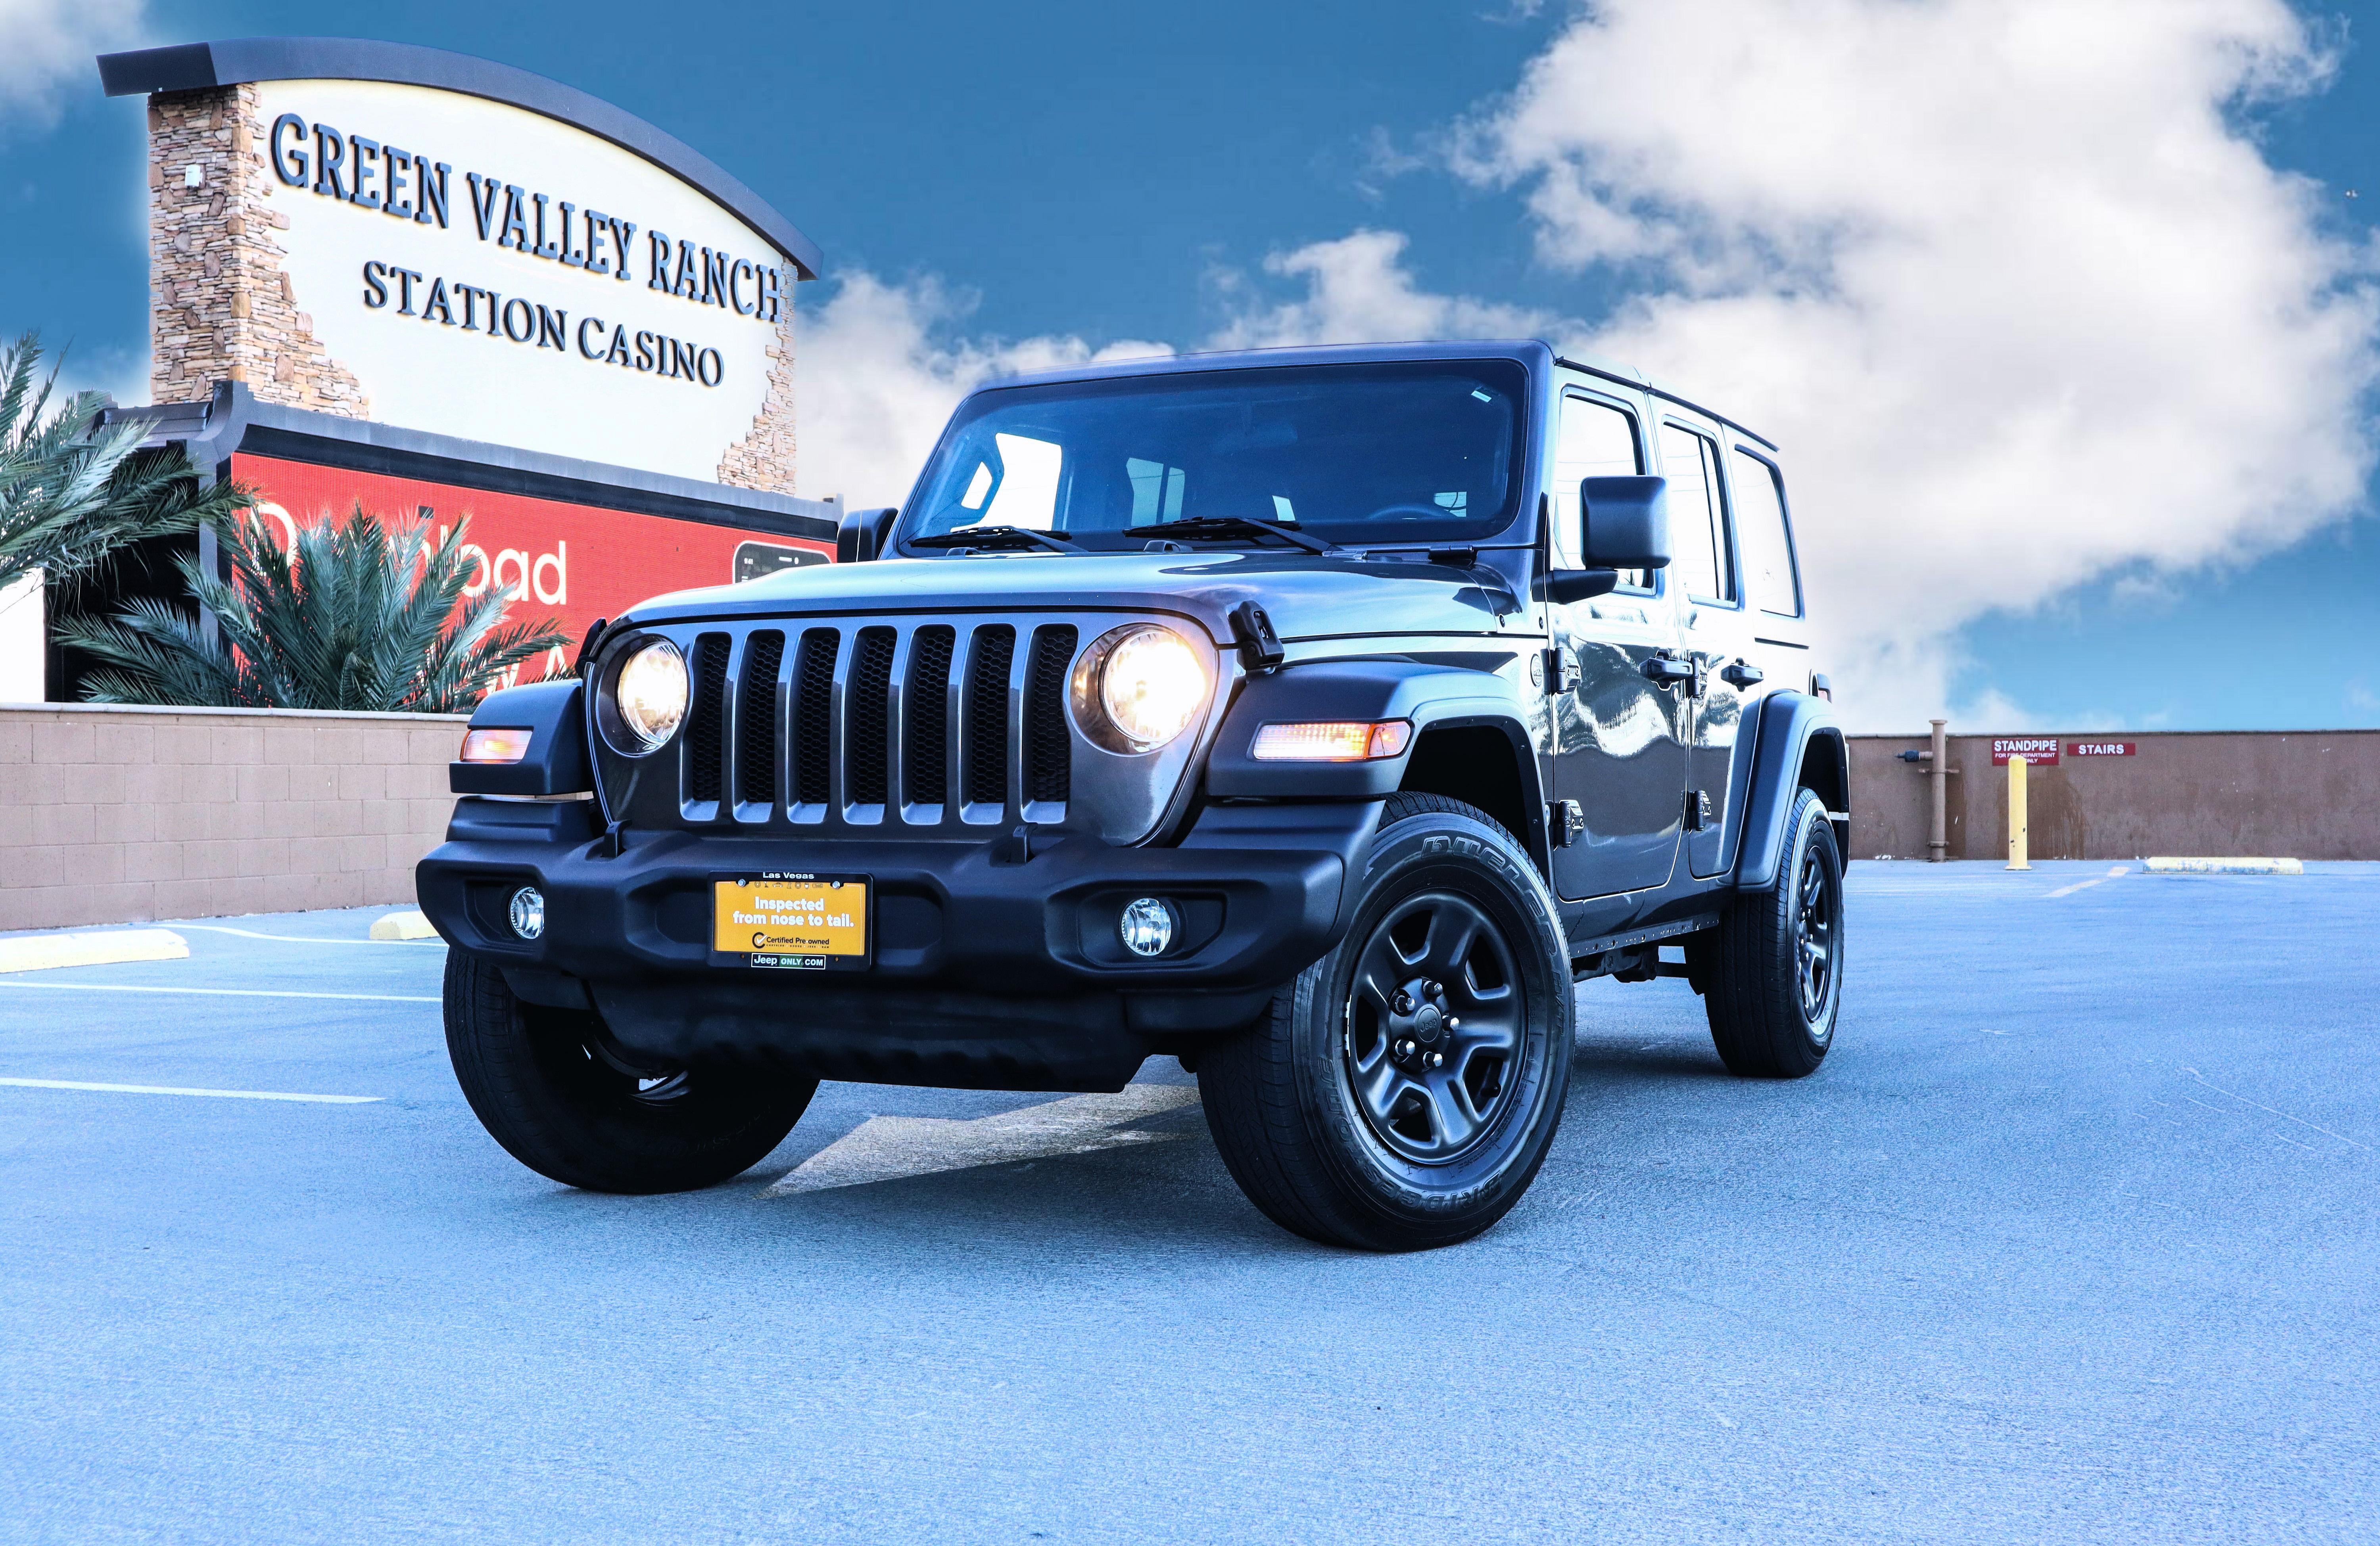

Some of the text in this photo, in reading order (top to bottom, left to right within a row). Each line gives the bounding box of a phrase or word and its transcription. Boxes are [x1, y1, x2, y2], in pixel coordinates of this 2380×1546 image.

[271, 113, 782, 322] GREEN VALLEY RANCH
[363, 261, 724, 387] STATION CASINO
[249, 501, 566, 605] Doad
[1994, 740, 2057, 752] STANDPIPE
[2079, 744, 2124, 755] STAIRS
[755, 896, 824, 912] Inspected
[1421, 835, 1557, 957] DUELER
[733, 911, 854, 927] from nose to tail.
[1420, 1019, 1437, 1032] Jeep
